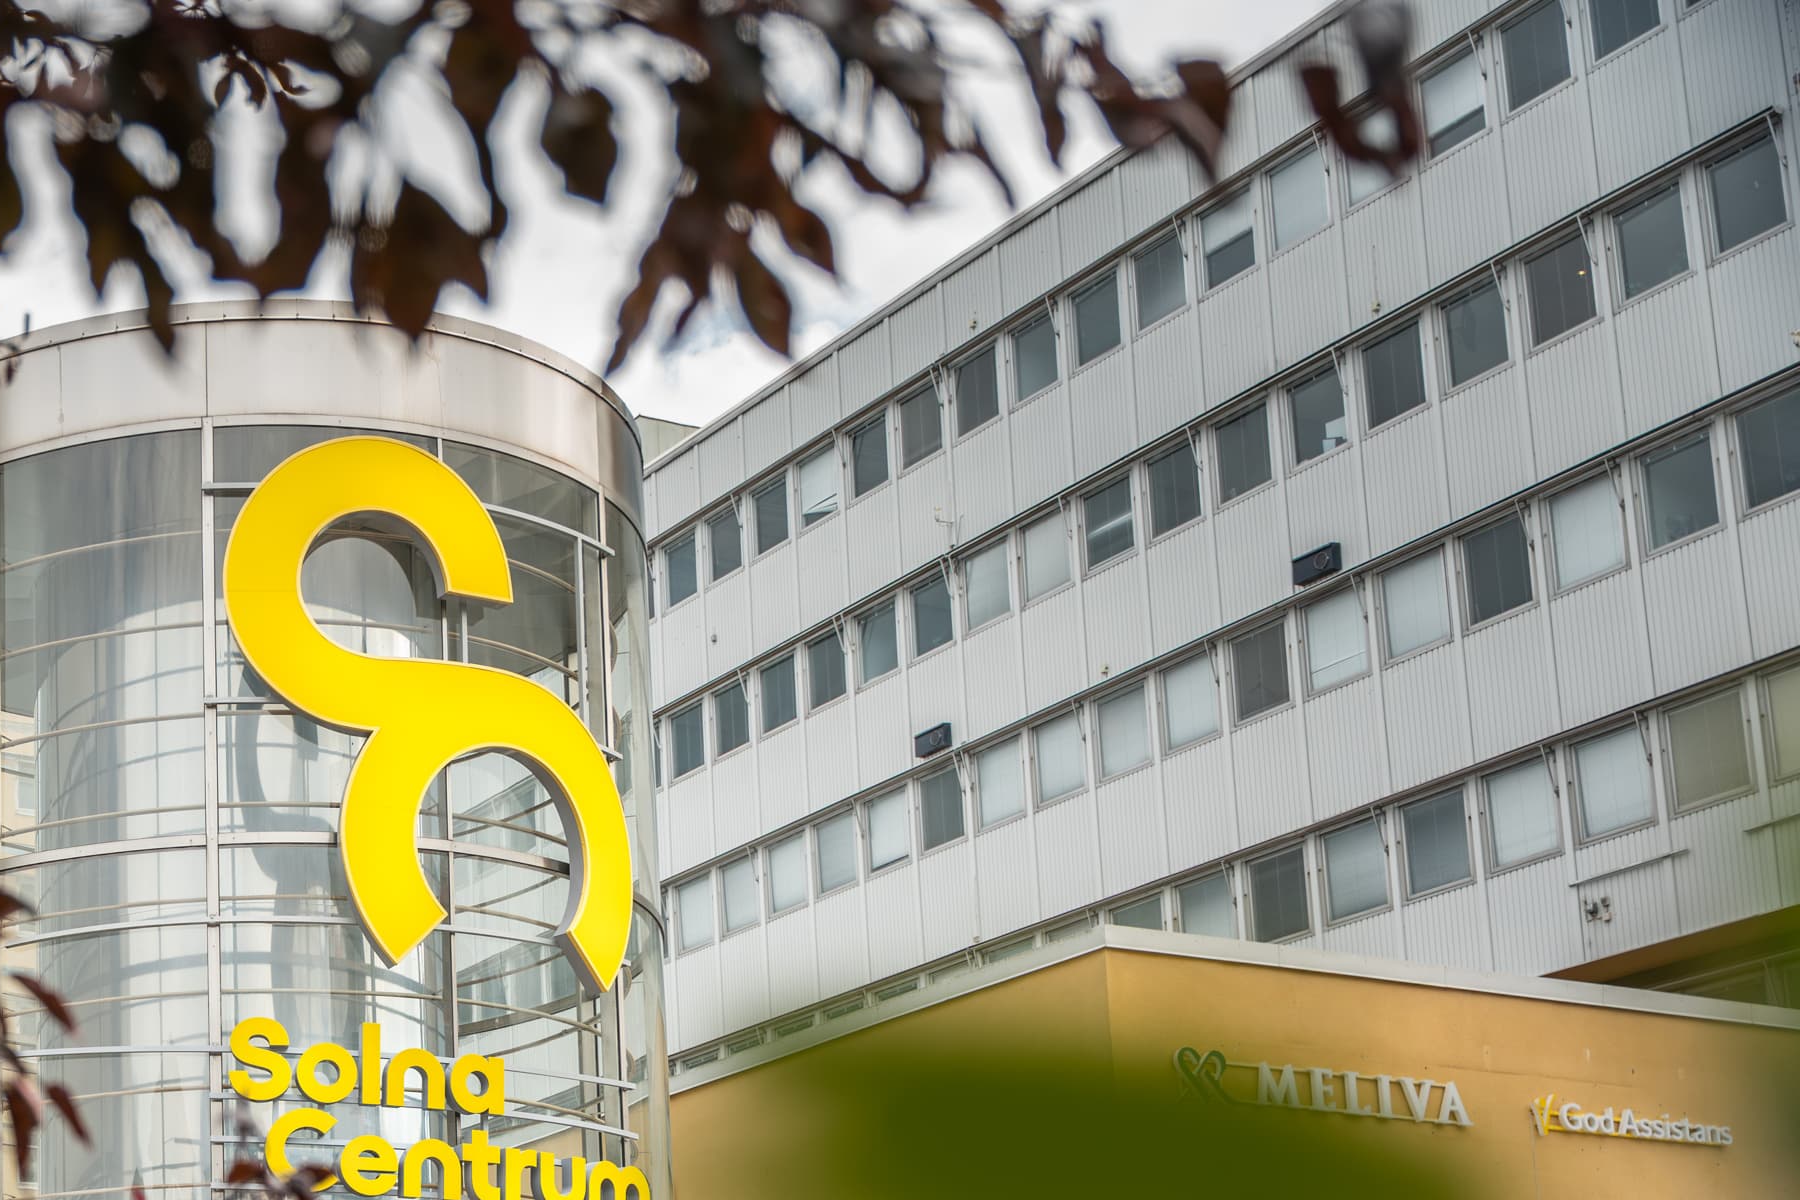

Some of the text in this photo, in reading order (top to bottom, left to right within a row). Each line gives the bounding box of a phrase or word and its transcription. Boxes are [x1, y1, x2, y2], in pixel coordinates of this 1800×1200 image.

[229, 1016, 505, 1115] Solna
[1258, 1062, 1473, 1127] MELIVA
[1559, 1103, 1733, 1145] God Assistans
